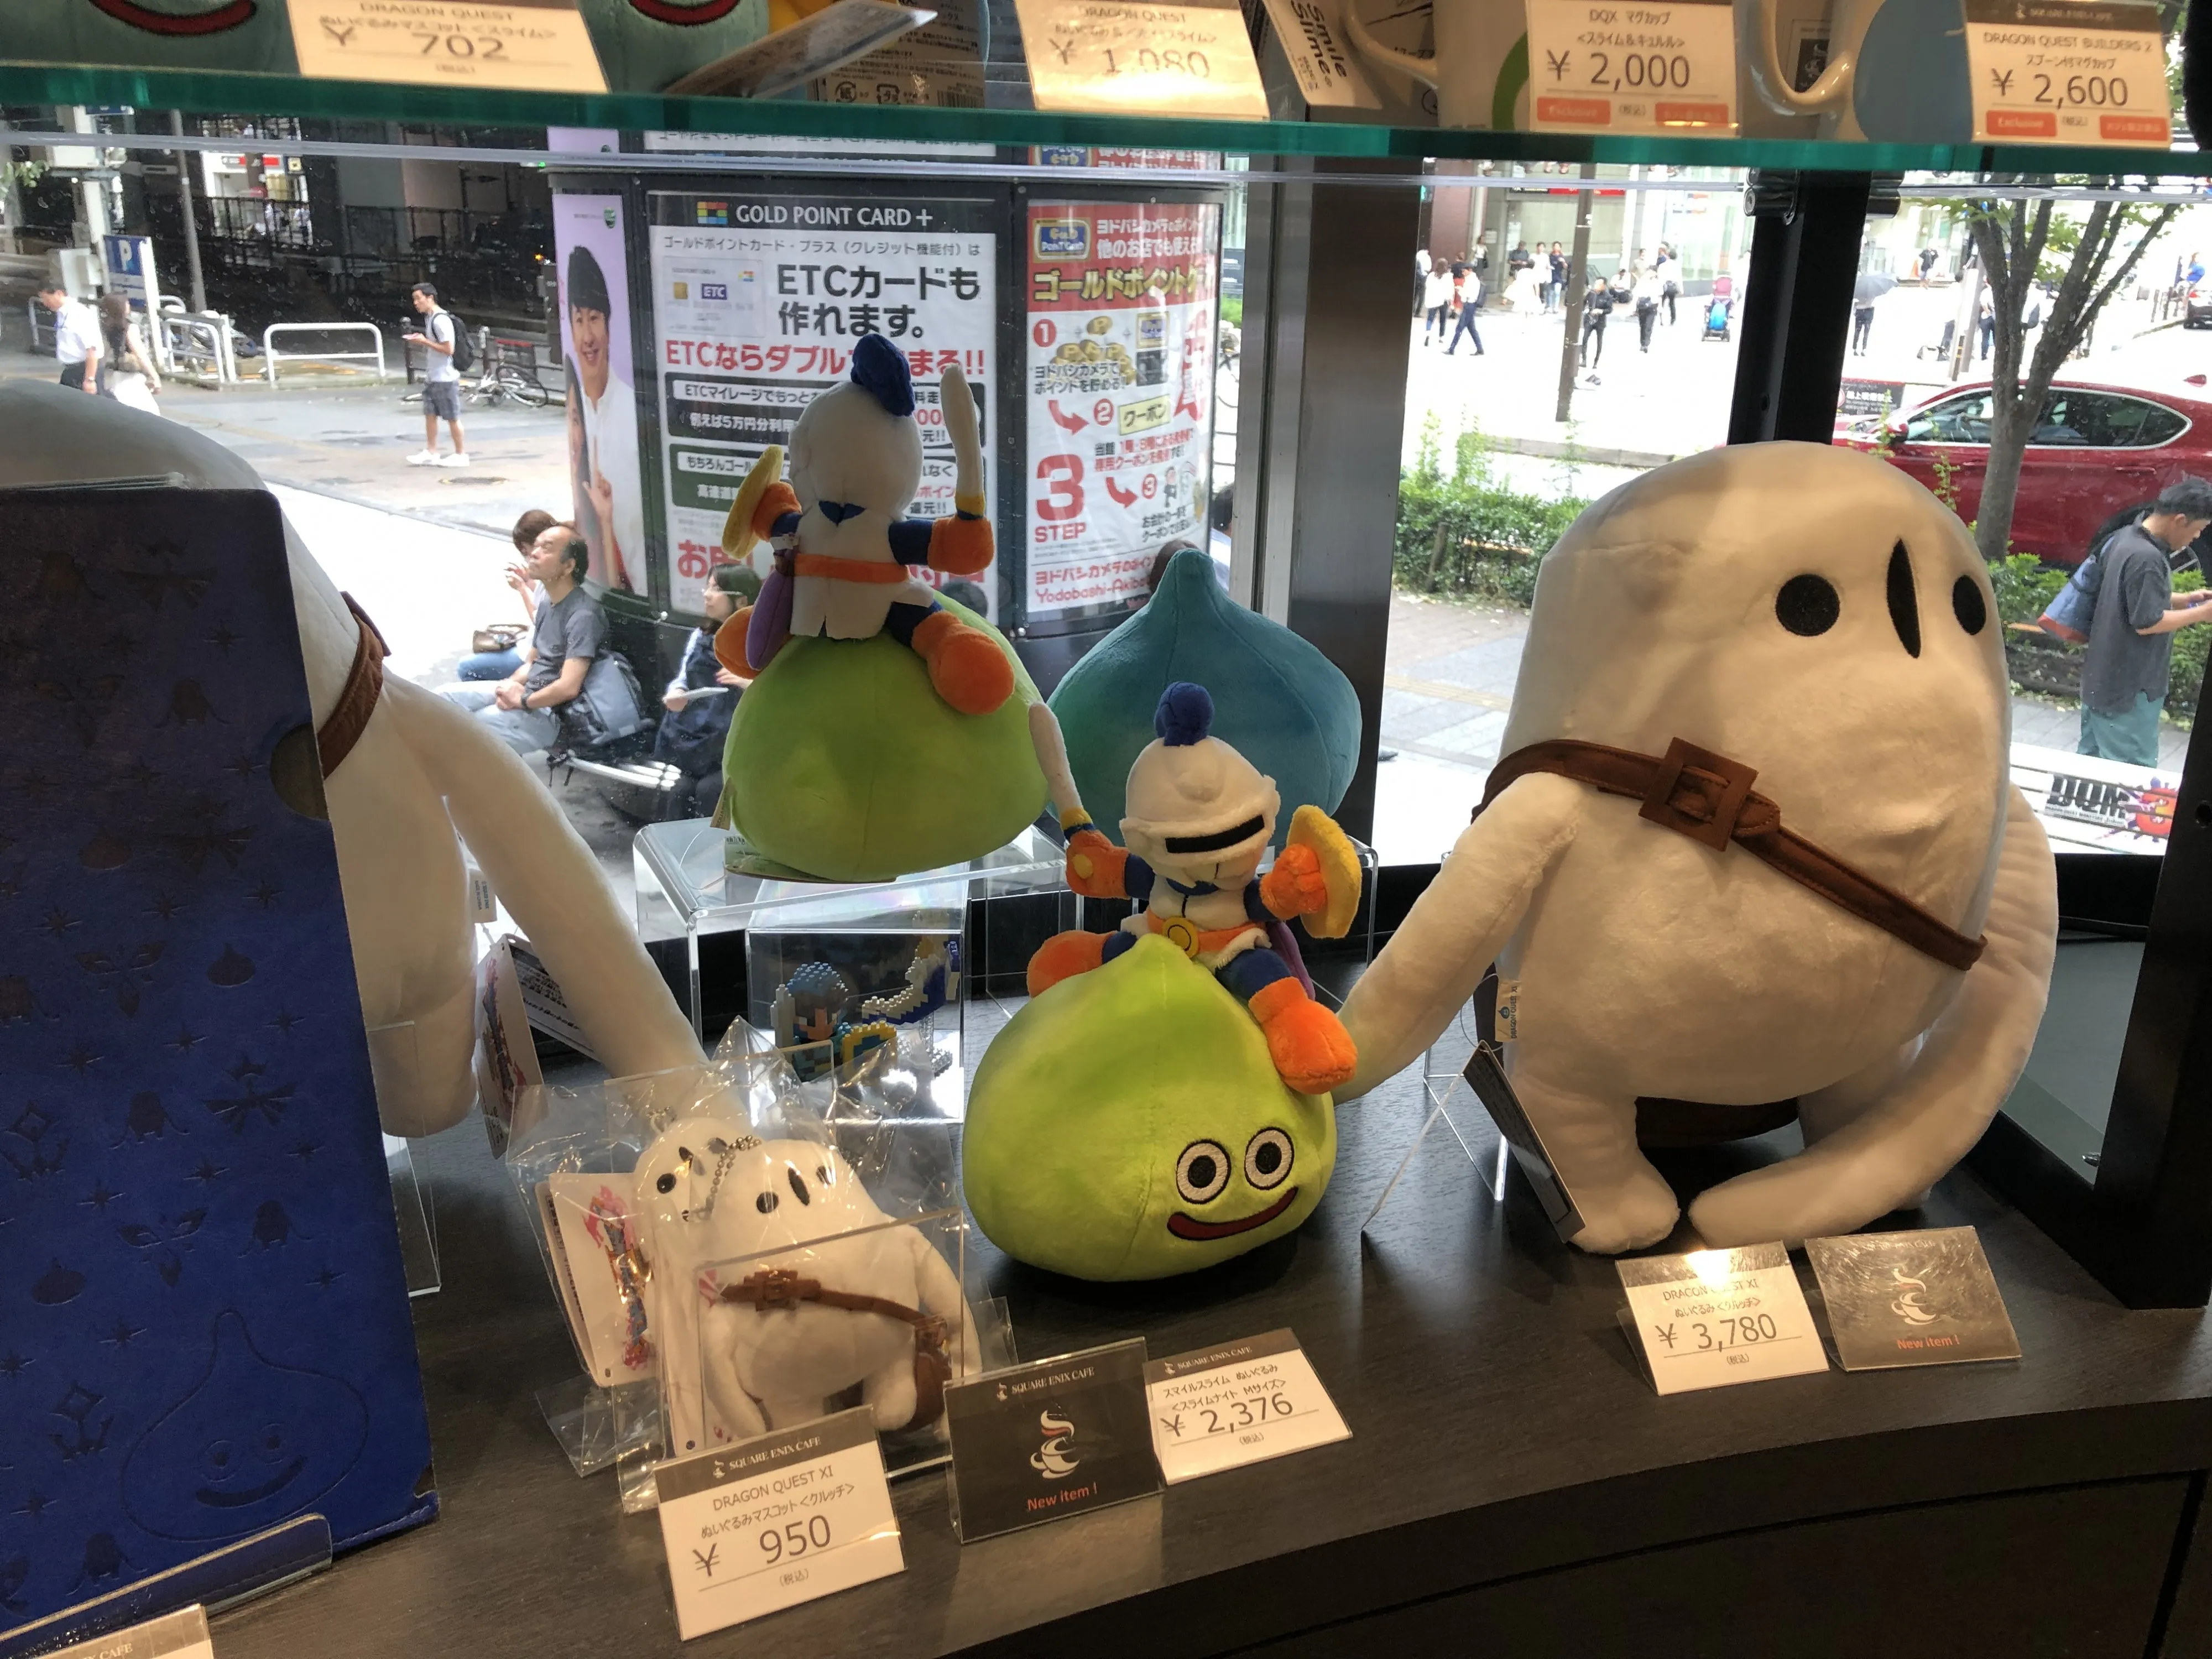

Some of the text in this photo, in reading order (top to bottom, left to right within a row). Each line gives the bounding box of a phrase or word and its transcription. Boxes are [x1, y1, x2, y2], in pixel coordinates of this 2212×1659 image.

[451, 7, 514, 21] QUEST
[411, 32, 510, 60] 702
[1983, 32, 2036, 45] DRAGON
[2039, 35, 2078, 48] QUEST
[1547, 49, 1691, 92] ¥ 2,000
[1991, 67, 2128, 109] ¥ 2,600
[735, 205, 787, 224] GOLD
[794, 206, 853, 225] POINT
[857, 207, 911, 227] CARD
[119, 239, 132, 271] P
[703, 286, 725, 298] ETC
[776, 263, 981, 300] ETCカードも
[778, 301, 924, 338] 作れます。
[1123, 405, 1167, 428] クーポン
[1035, 453, 1085, 521] 3
[1035, 521, 1087, 543] STEP
[1662, 1285, 1708, 1301] DRAGON
[1746, 1279, 1759, 1289] XI
[1655, 1313, 1777, 1353] ¥ 3,780
[1896, 1338, 1924, 1350] New
[1011, 1366, 1095, 1395] SQUARE ENIX CAFE
[1162, 1363, 1279, 1398] スマイルスライム ぬいぐるみ
[1160, 1391, 1294, 1437] ¥ 2,376
[729, 1436, 822, 1470] SQUARE ENIX CAFE
[713, 1465, 834, 1511] DRAGON QUEST XI
[1027, 1494, 1057, 1511] New
[692, 1514, 832, 1578] ¥ 950
[99, 1643, 133, 1659] CAFE
